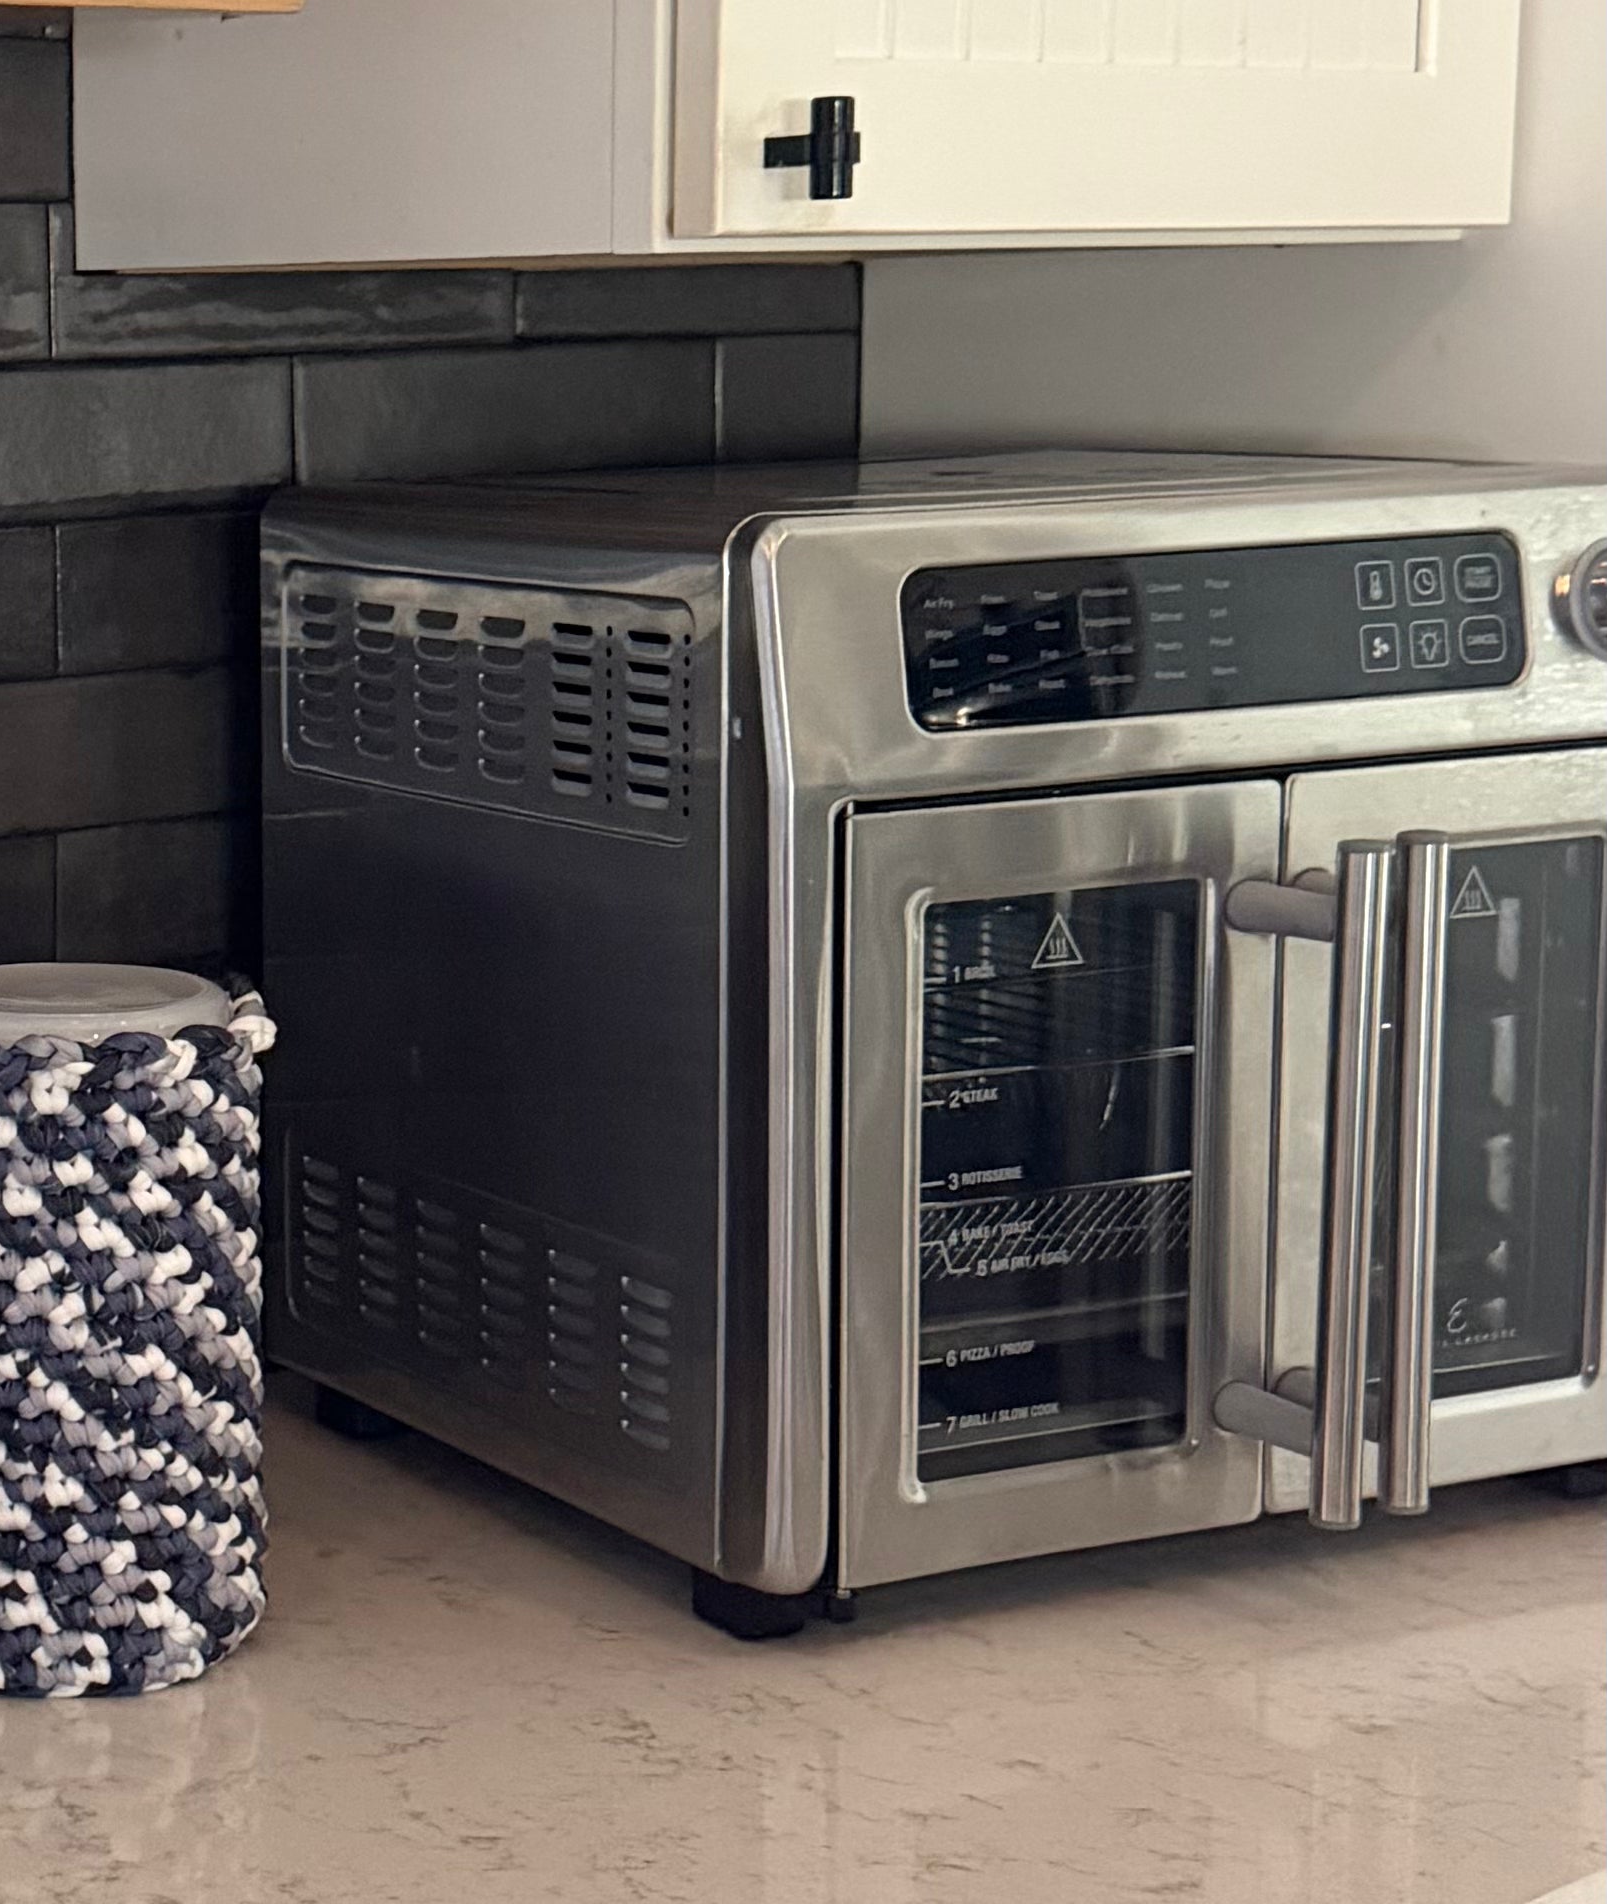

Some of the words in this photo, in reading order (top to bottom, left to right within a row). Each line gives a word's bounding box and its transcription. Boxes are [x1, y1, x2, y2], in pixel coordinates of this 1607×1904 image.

[952, 965, 961, 983] 1
[949, 1090, 961, 1109] 2
[948, 1172, 960, 1191] 3
[946, 1349, 957, 1368] 6
[960, 1346, 991, 1362] PIZZA
[946, 1416, 957, 1434] 7
